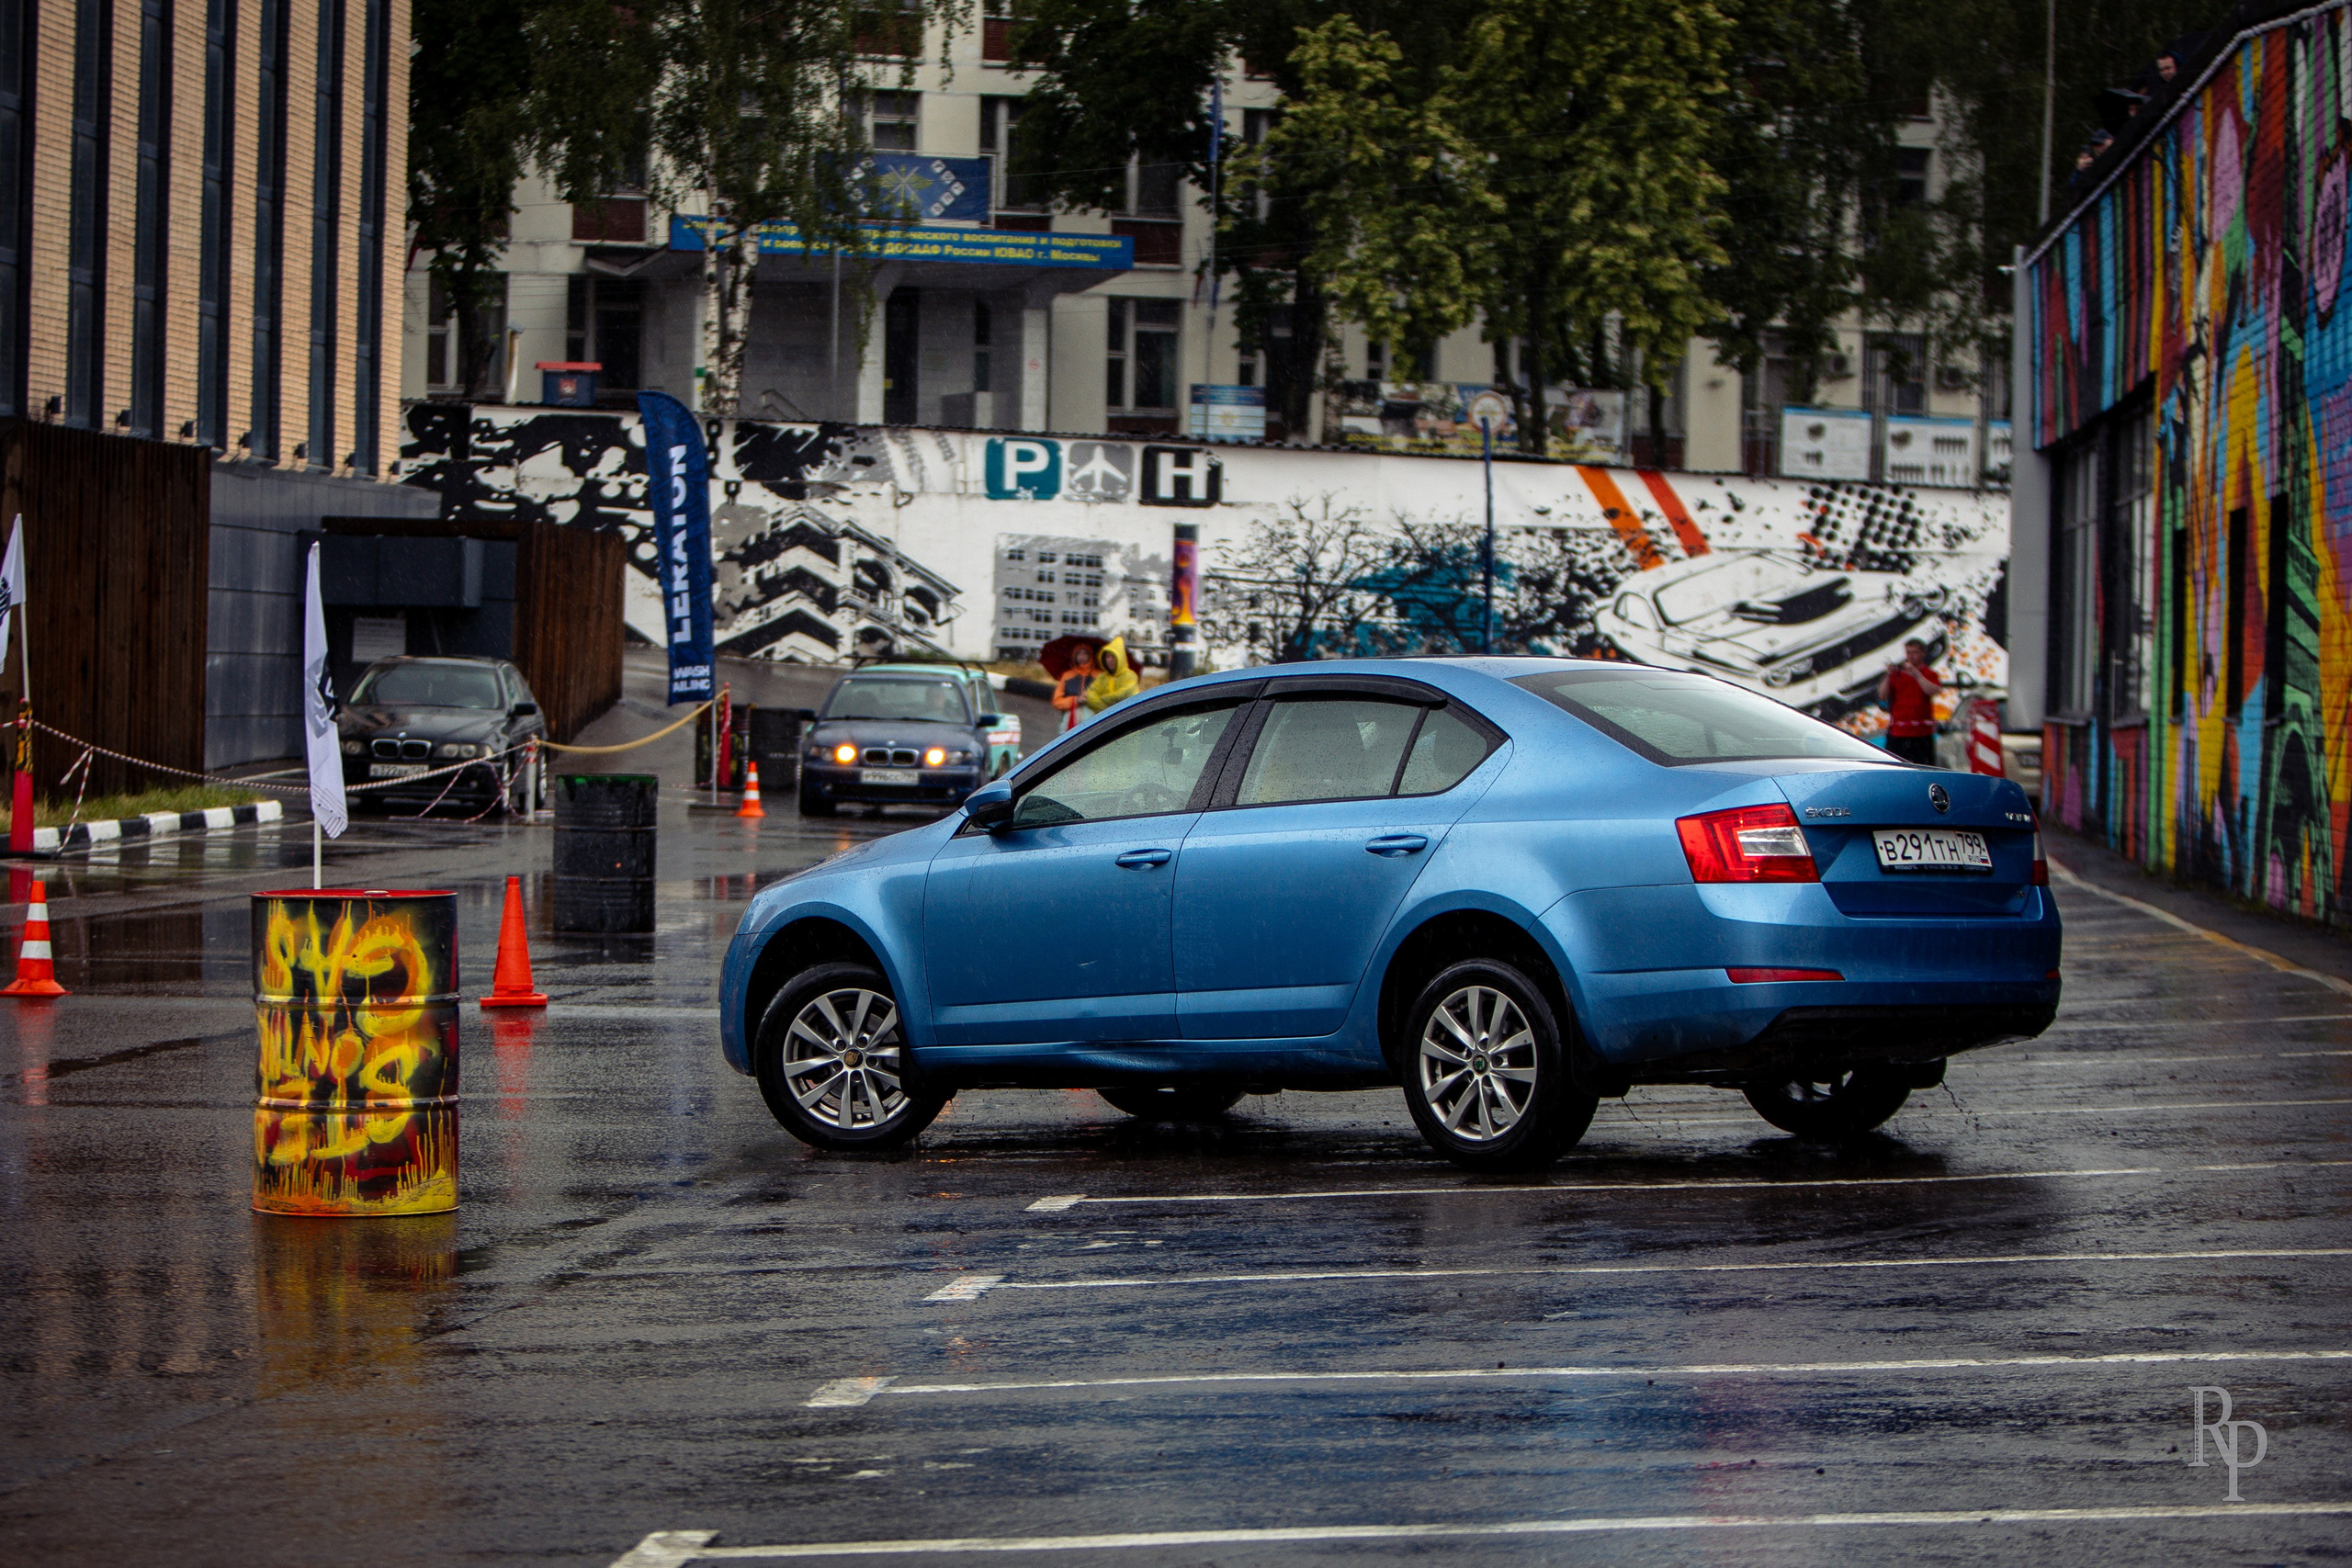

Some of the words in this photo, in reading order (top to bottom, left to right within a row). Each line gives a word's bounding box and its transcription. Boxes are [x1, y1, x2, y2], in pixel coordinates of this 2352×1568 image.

[944, 244, 991, 257] России
[994, 246, 1035, 259] ЮВАО
[1050, 249, 1101, 262] Москвы
[1002, 440, 1050, 491] P
[1157, 452, 1209, 500] H
[673, 665, 710, 680] WASH
[1805, 807, 1852, 818] ŠKODA
[1968, 854, 1981, 863] RUS
